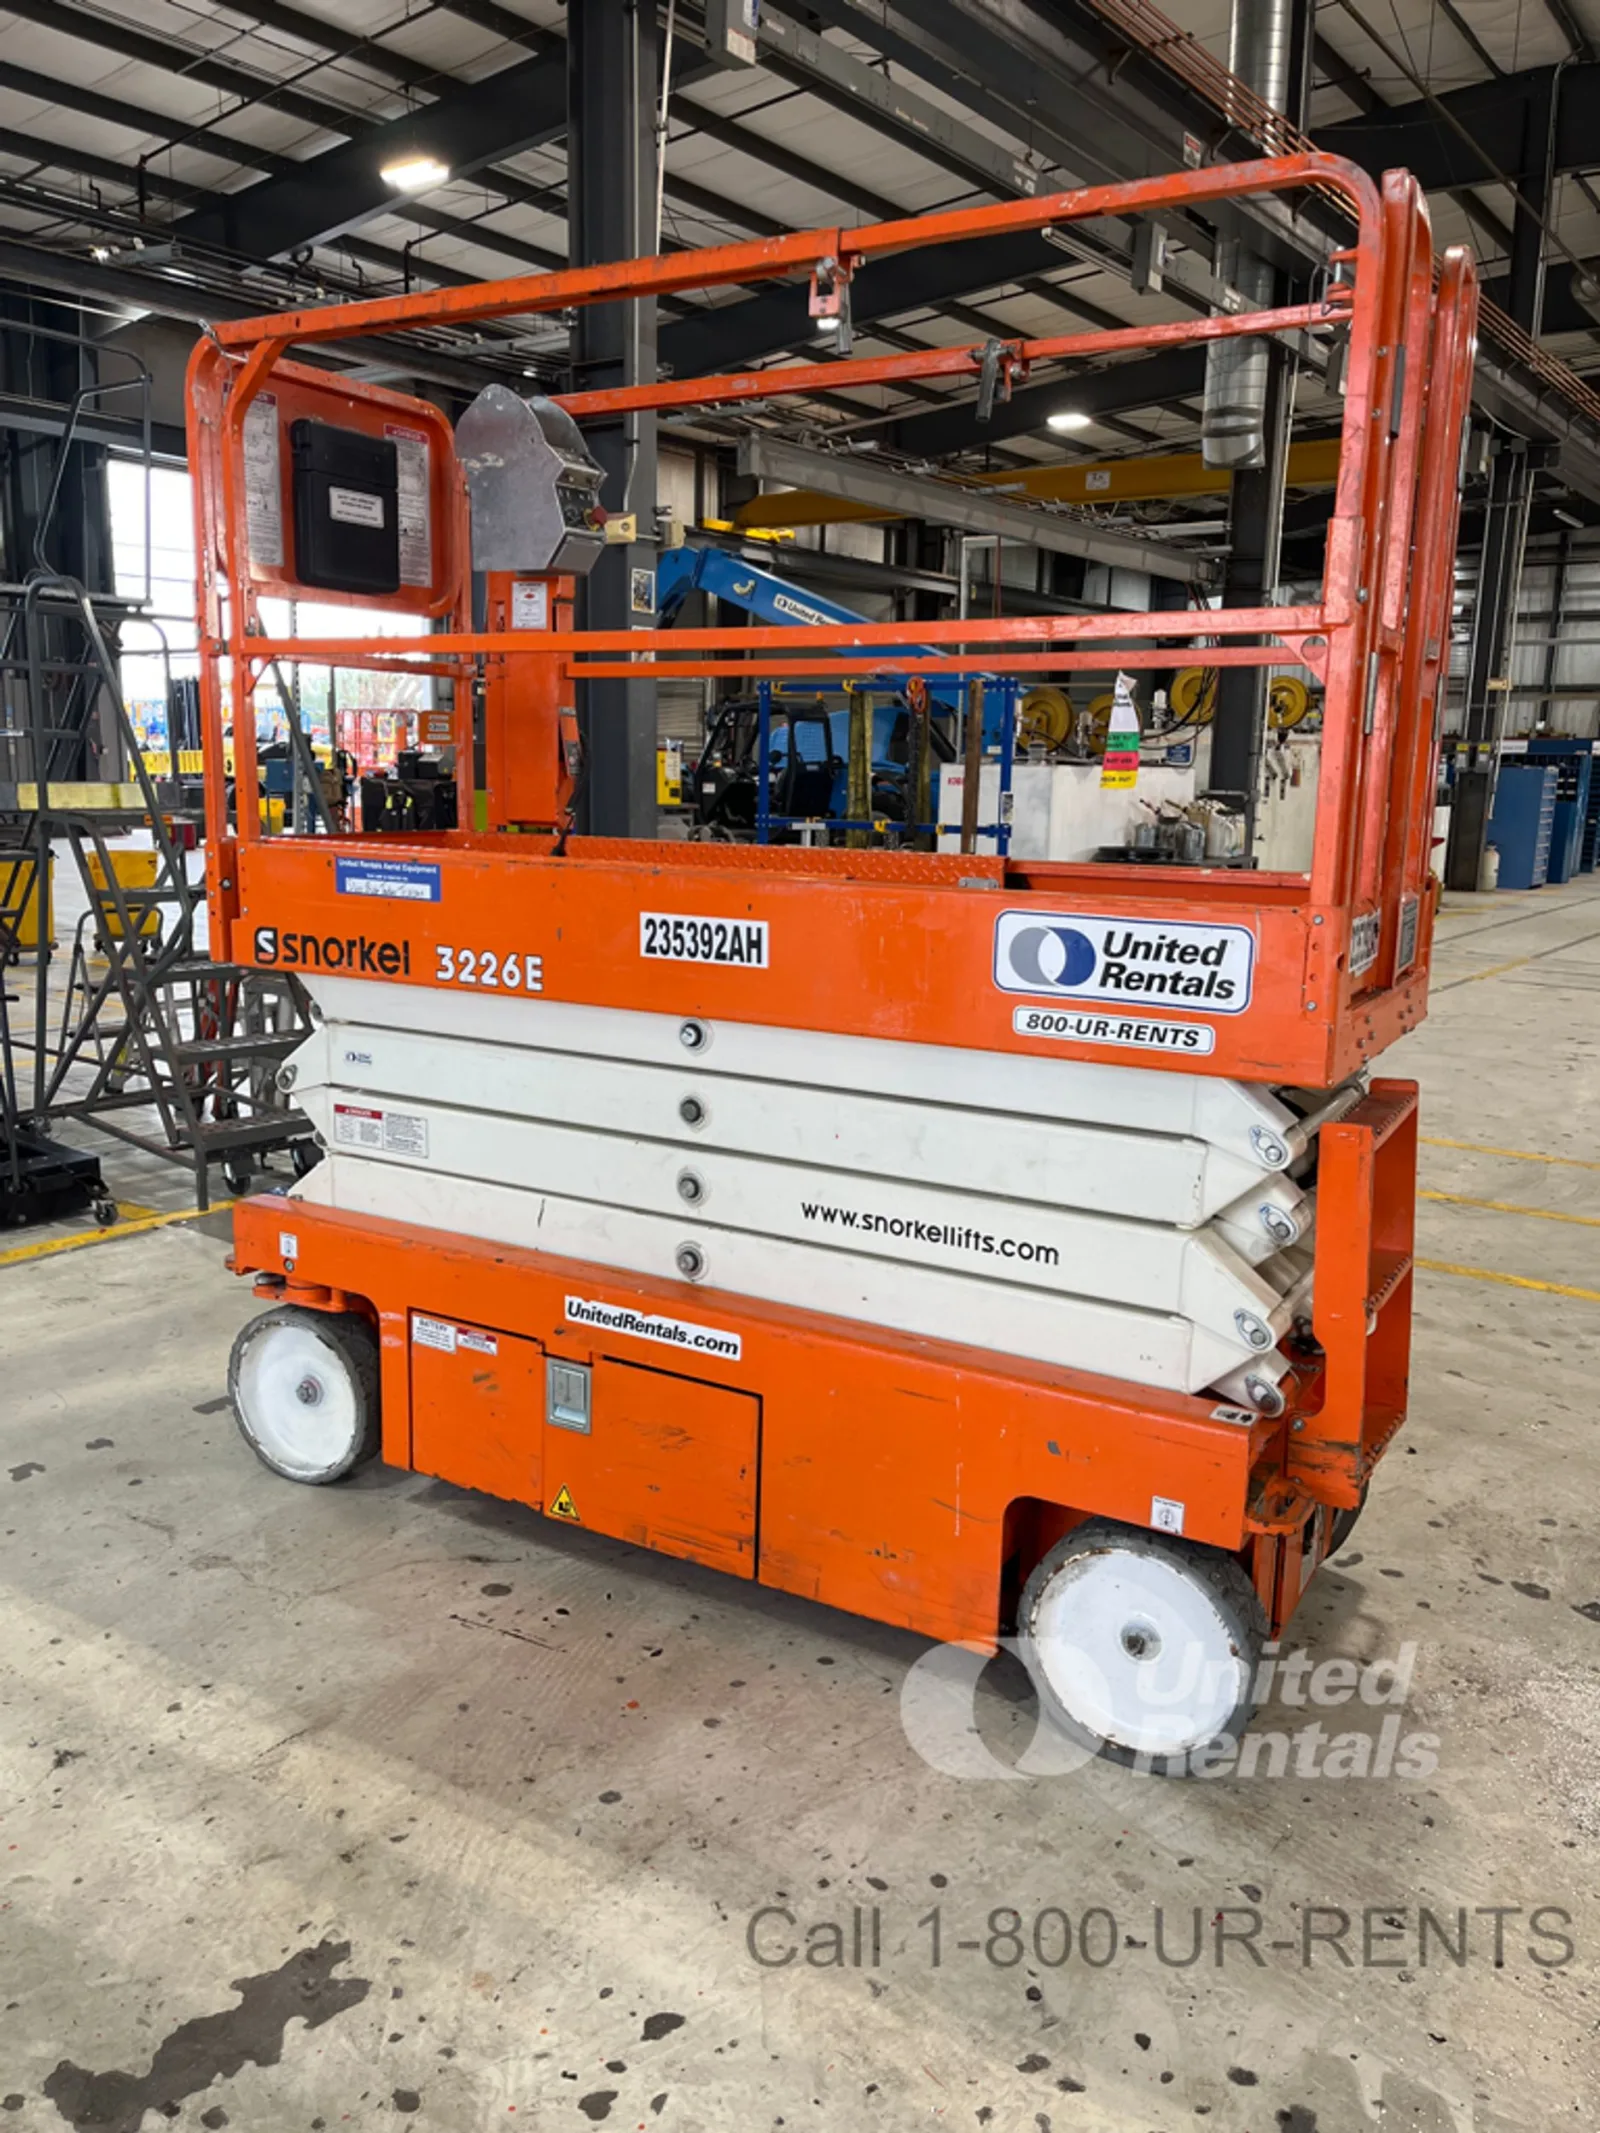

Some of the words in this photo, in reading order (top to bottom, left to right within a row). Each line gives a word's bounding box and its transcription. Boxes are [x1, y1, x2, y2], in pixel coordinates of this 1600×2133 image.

[282, 932, 410, 976] snorkel
[435, 944, 543, 991] 3226E
[644, 917, 763, 964] 235392AH
[1102, 930, 1228, 967] United
[1098, 961, 1236, 1000] Rentals
[1026, 1013, 1199, 1047] 800-UR-RENTS
[801, 1202, 1059, 1266] www.snorkellifts.com
[567, 1301, 738, 1355] UnitedRentals.com
